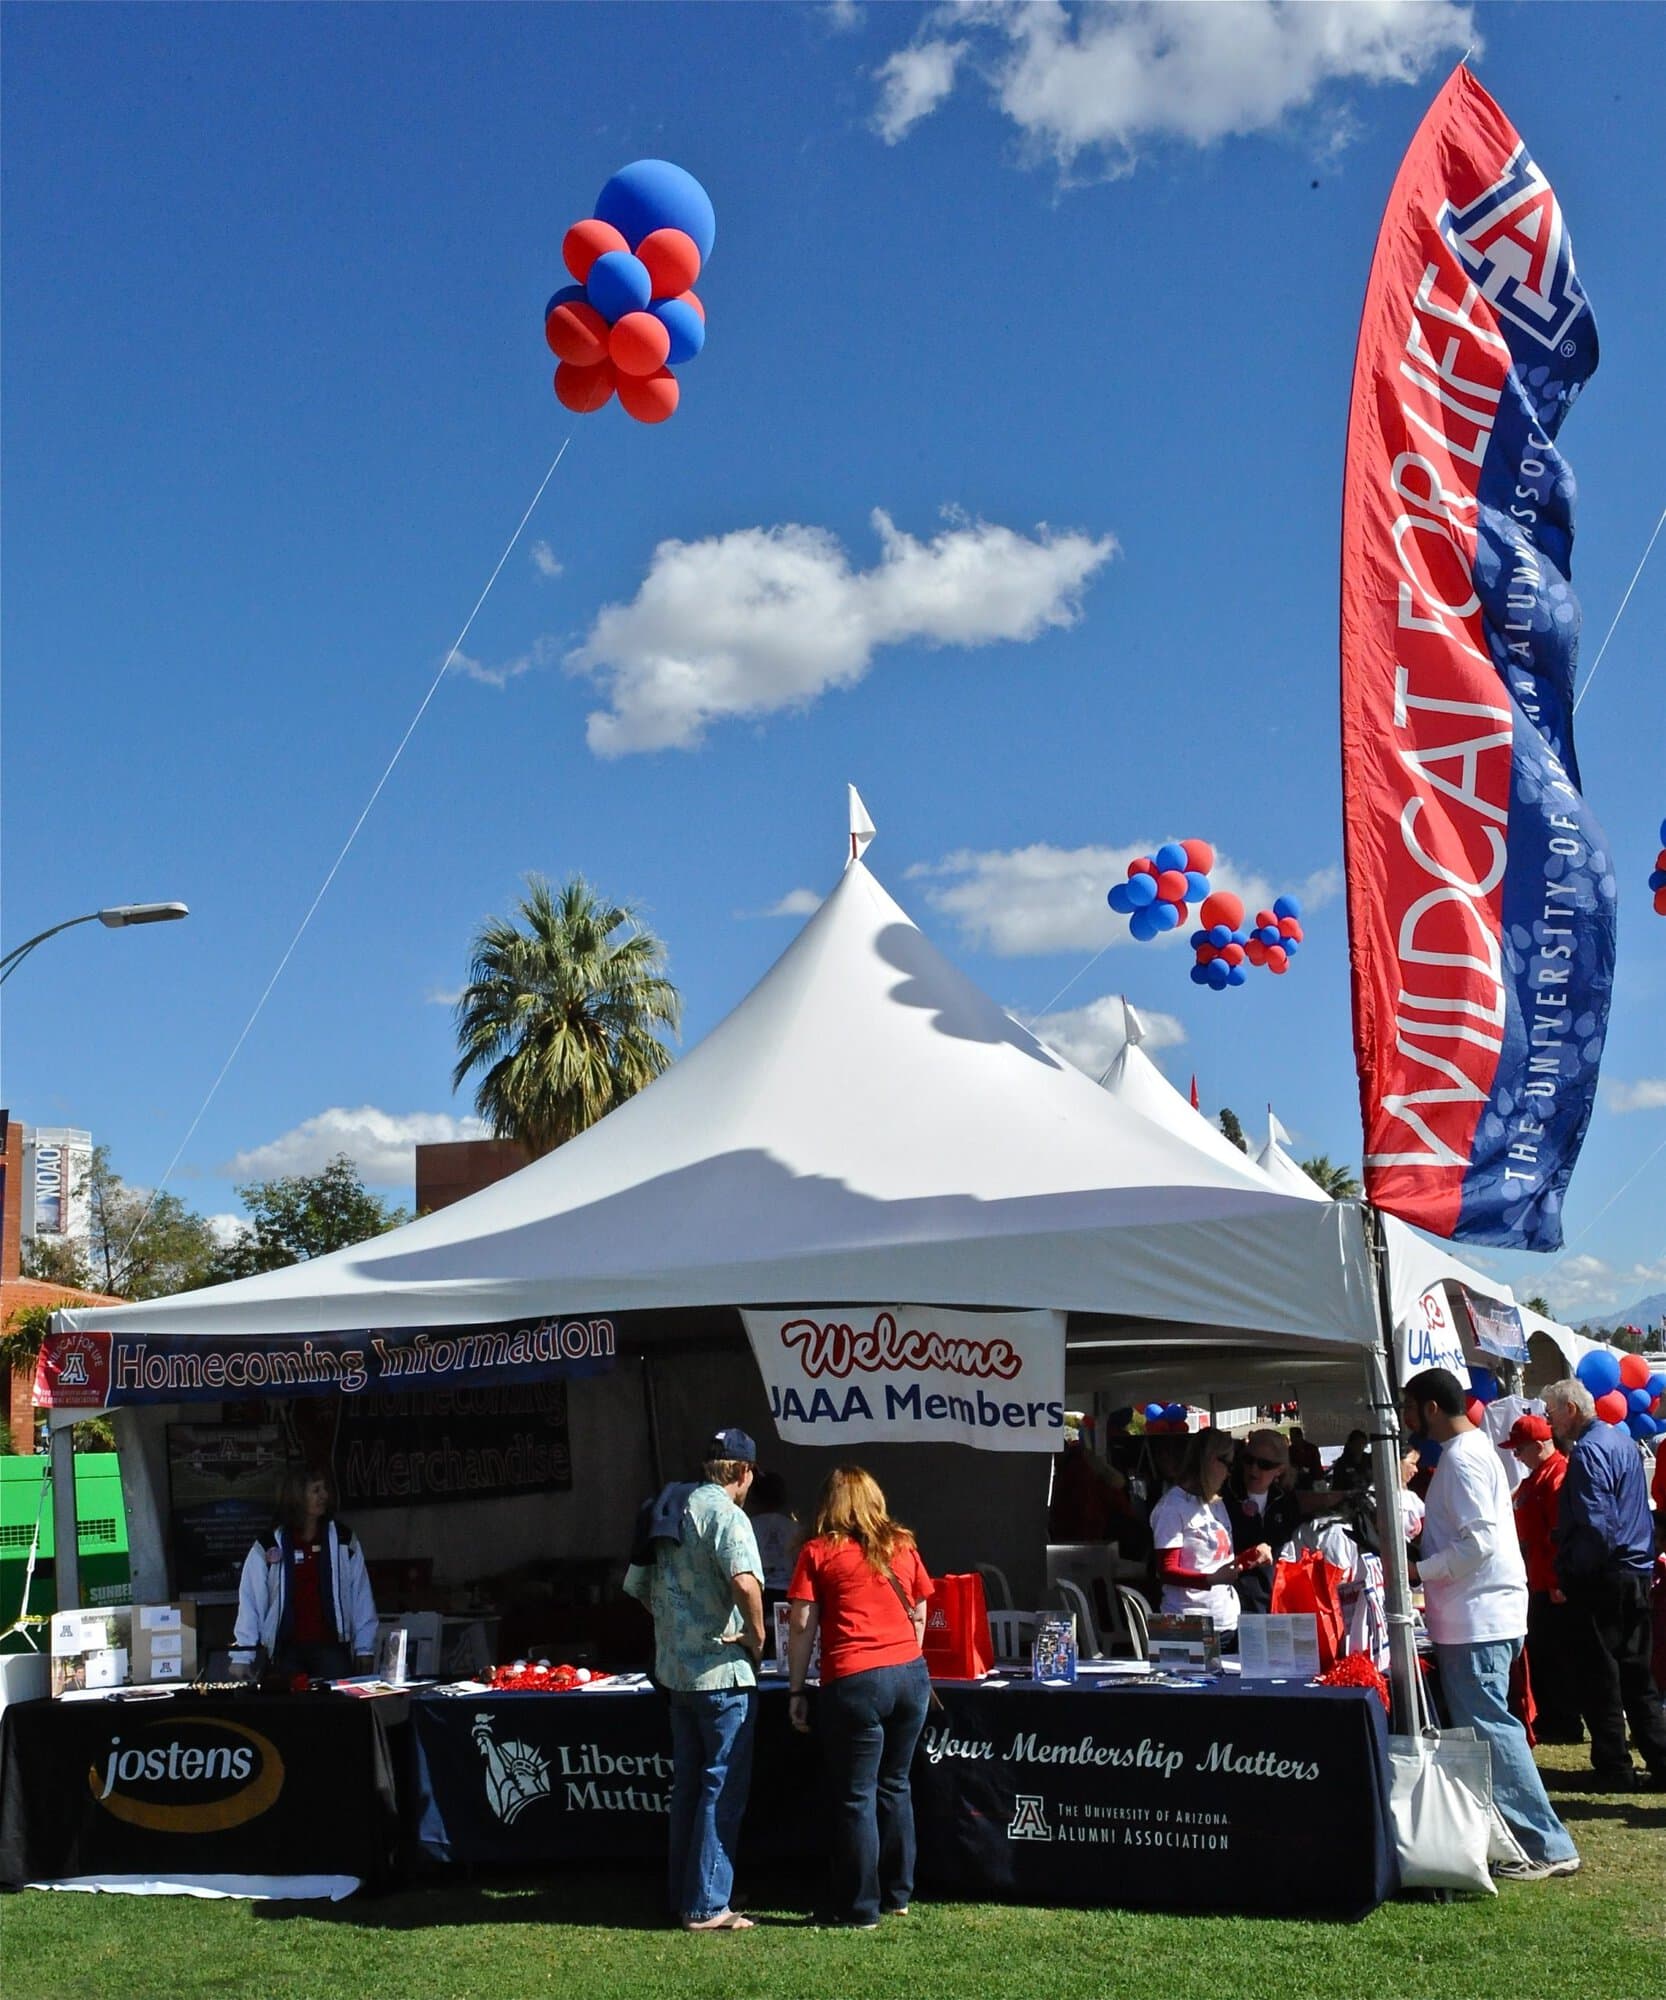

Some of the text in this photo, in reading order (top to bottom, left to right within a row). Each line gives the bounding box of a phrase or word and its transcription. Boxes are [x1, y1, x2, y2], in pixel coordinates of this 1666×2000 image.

[1363, 261, 1514, 1168] WILDCAT FOR LIFE
[1548, 814, 1581, 857] OF
[1525, 881, 1578, 1098] UNIVERSITY
[35, 1147, 61, 1200] NOAO
[1504, 1120, 1545, 1182] THE
[116, 1318, 617, 1392] Homecoming Information
[780, 1311, 1023, 1380] Welcome
[885, 1383, 1064, 1429] Members
[346, 1433, 571, 1497] Merchandise
[100, 1736, 253, 1801] jostens
[923, 1727, 1321, 1781] Your Membership Matters
[1058, 1824, 1229, 1850] ALUMNI ASSOCIATION
